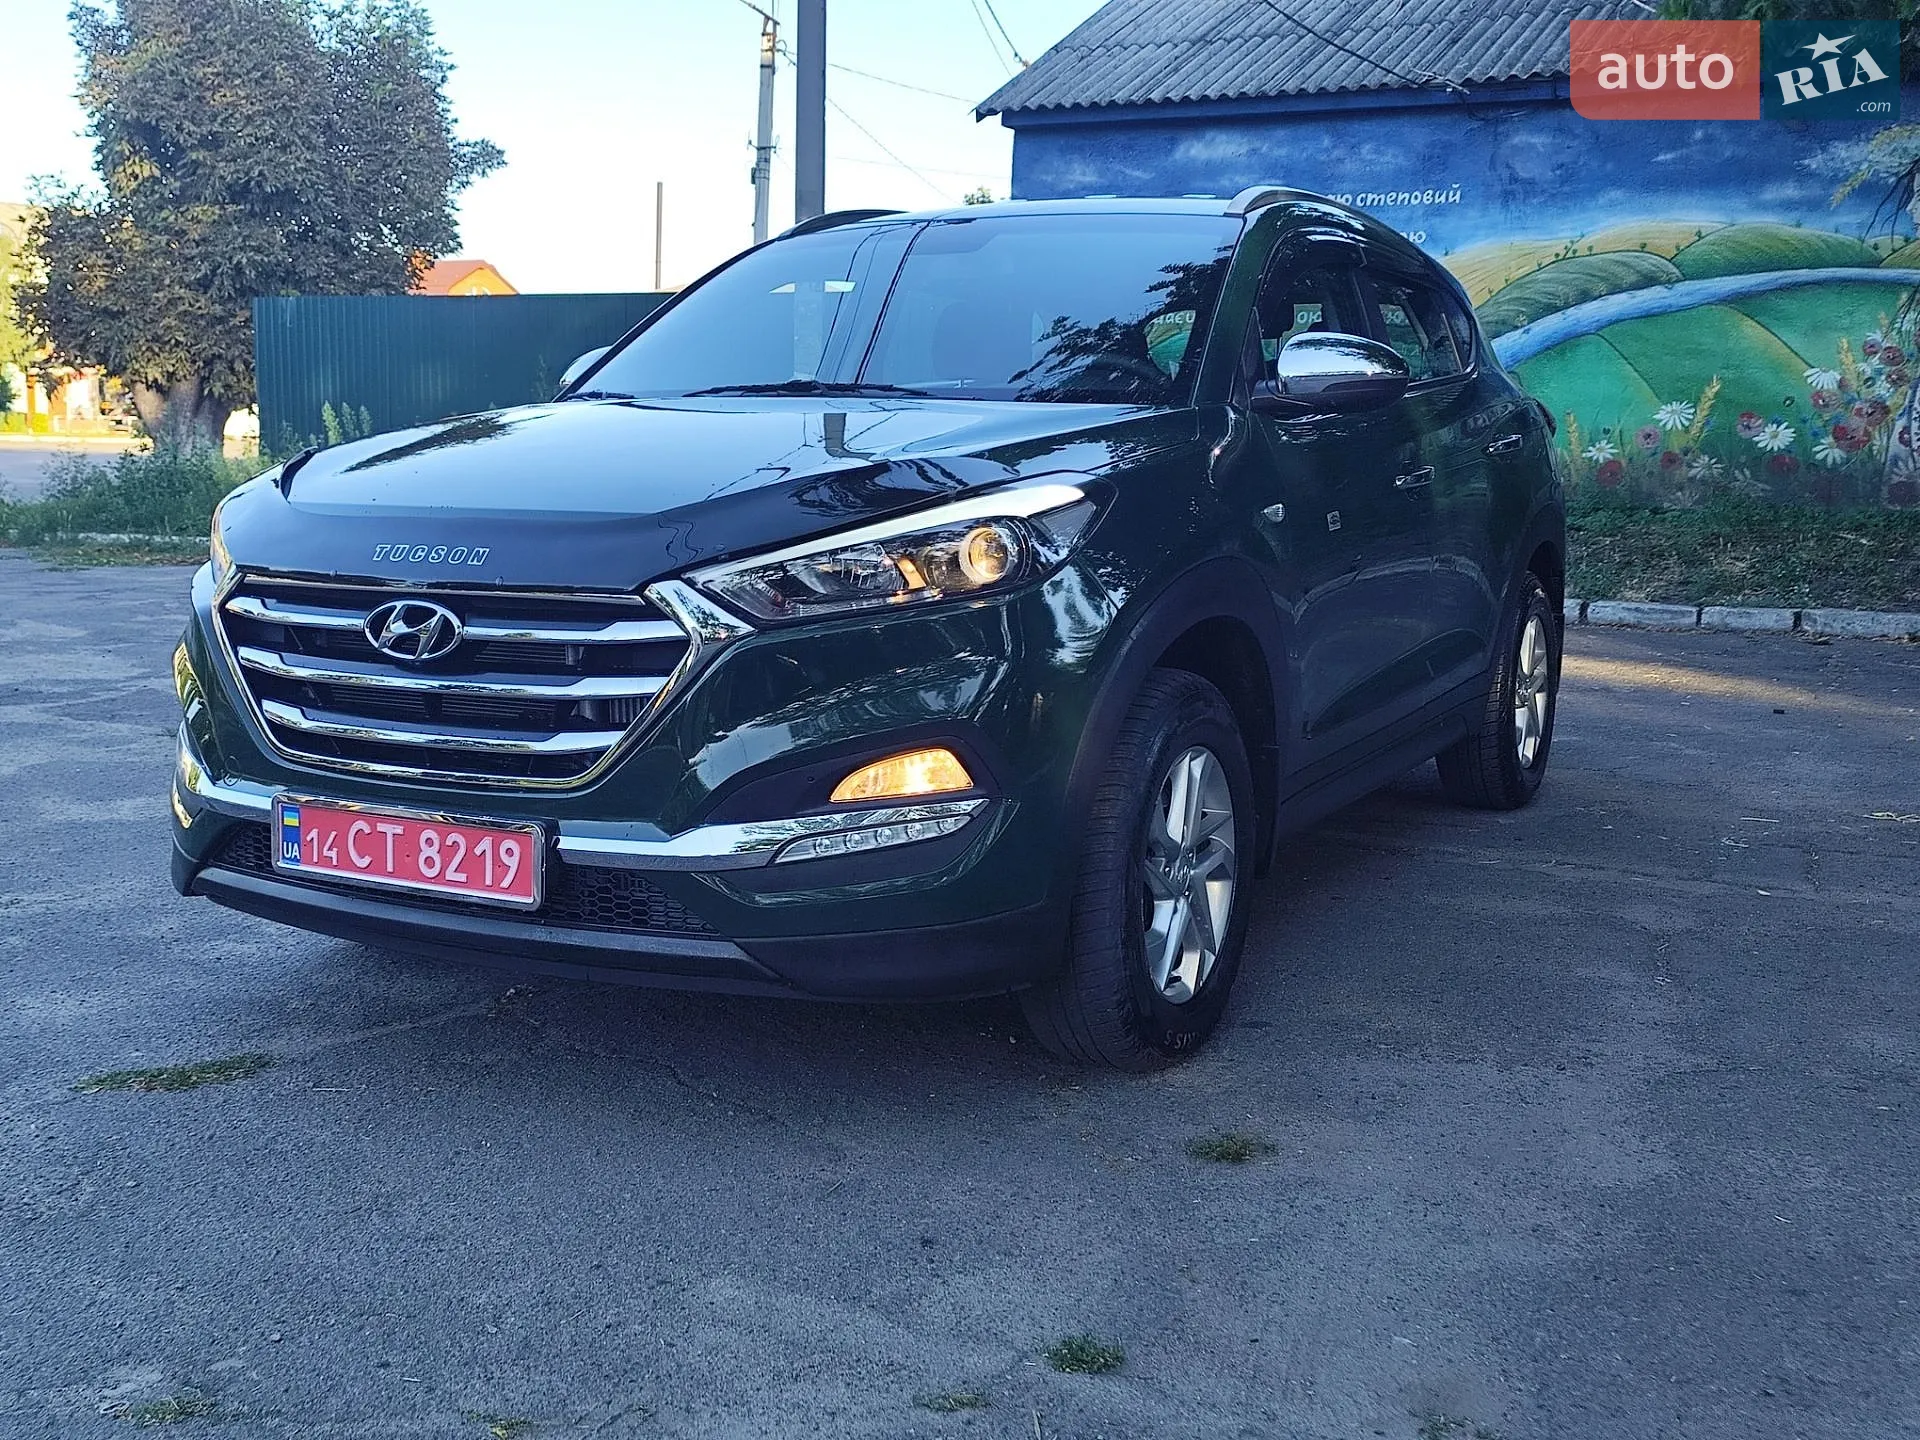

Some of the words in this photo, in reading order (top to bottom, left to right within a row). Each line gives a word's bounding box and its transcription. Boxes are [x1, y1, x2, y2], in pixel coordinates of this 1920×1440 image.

[1356, 184, 1461, 207] степовий
[372, 544, 490, 565] TUCSON
[283, 841, 300, 859] UA
[306, 828, 338, 866] 14
[347, 819, 404, 874] CT
[417, 828, 521, 889] 8219
